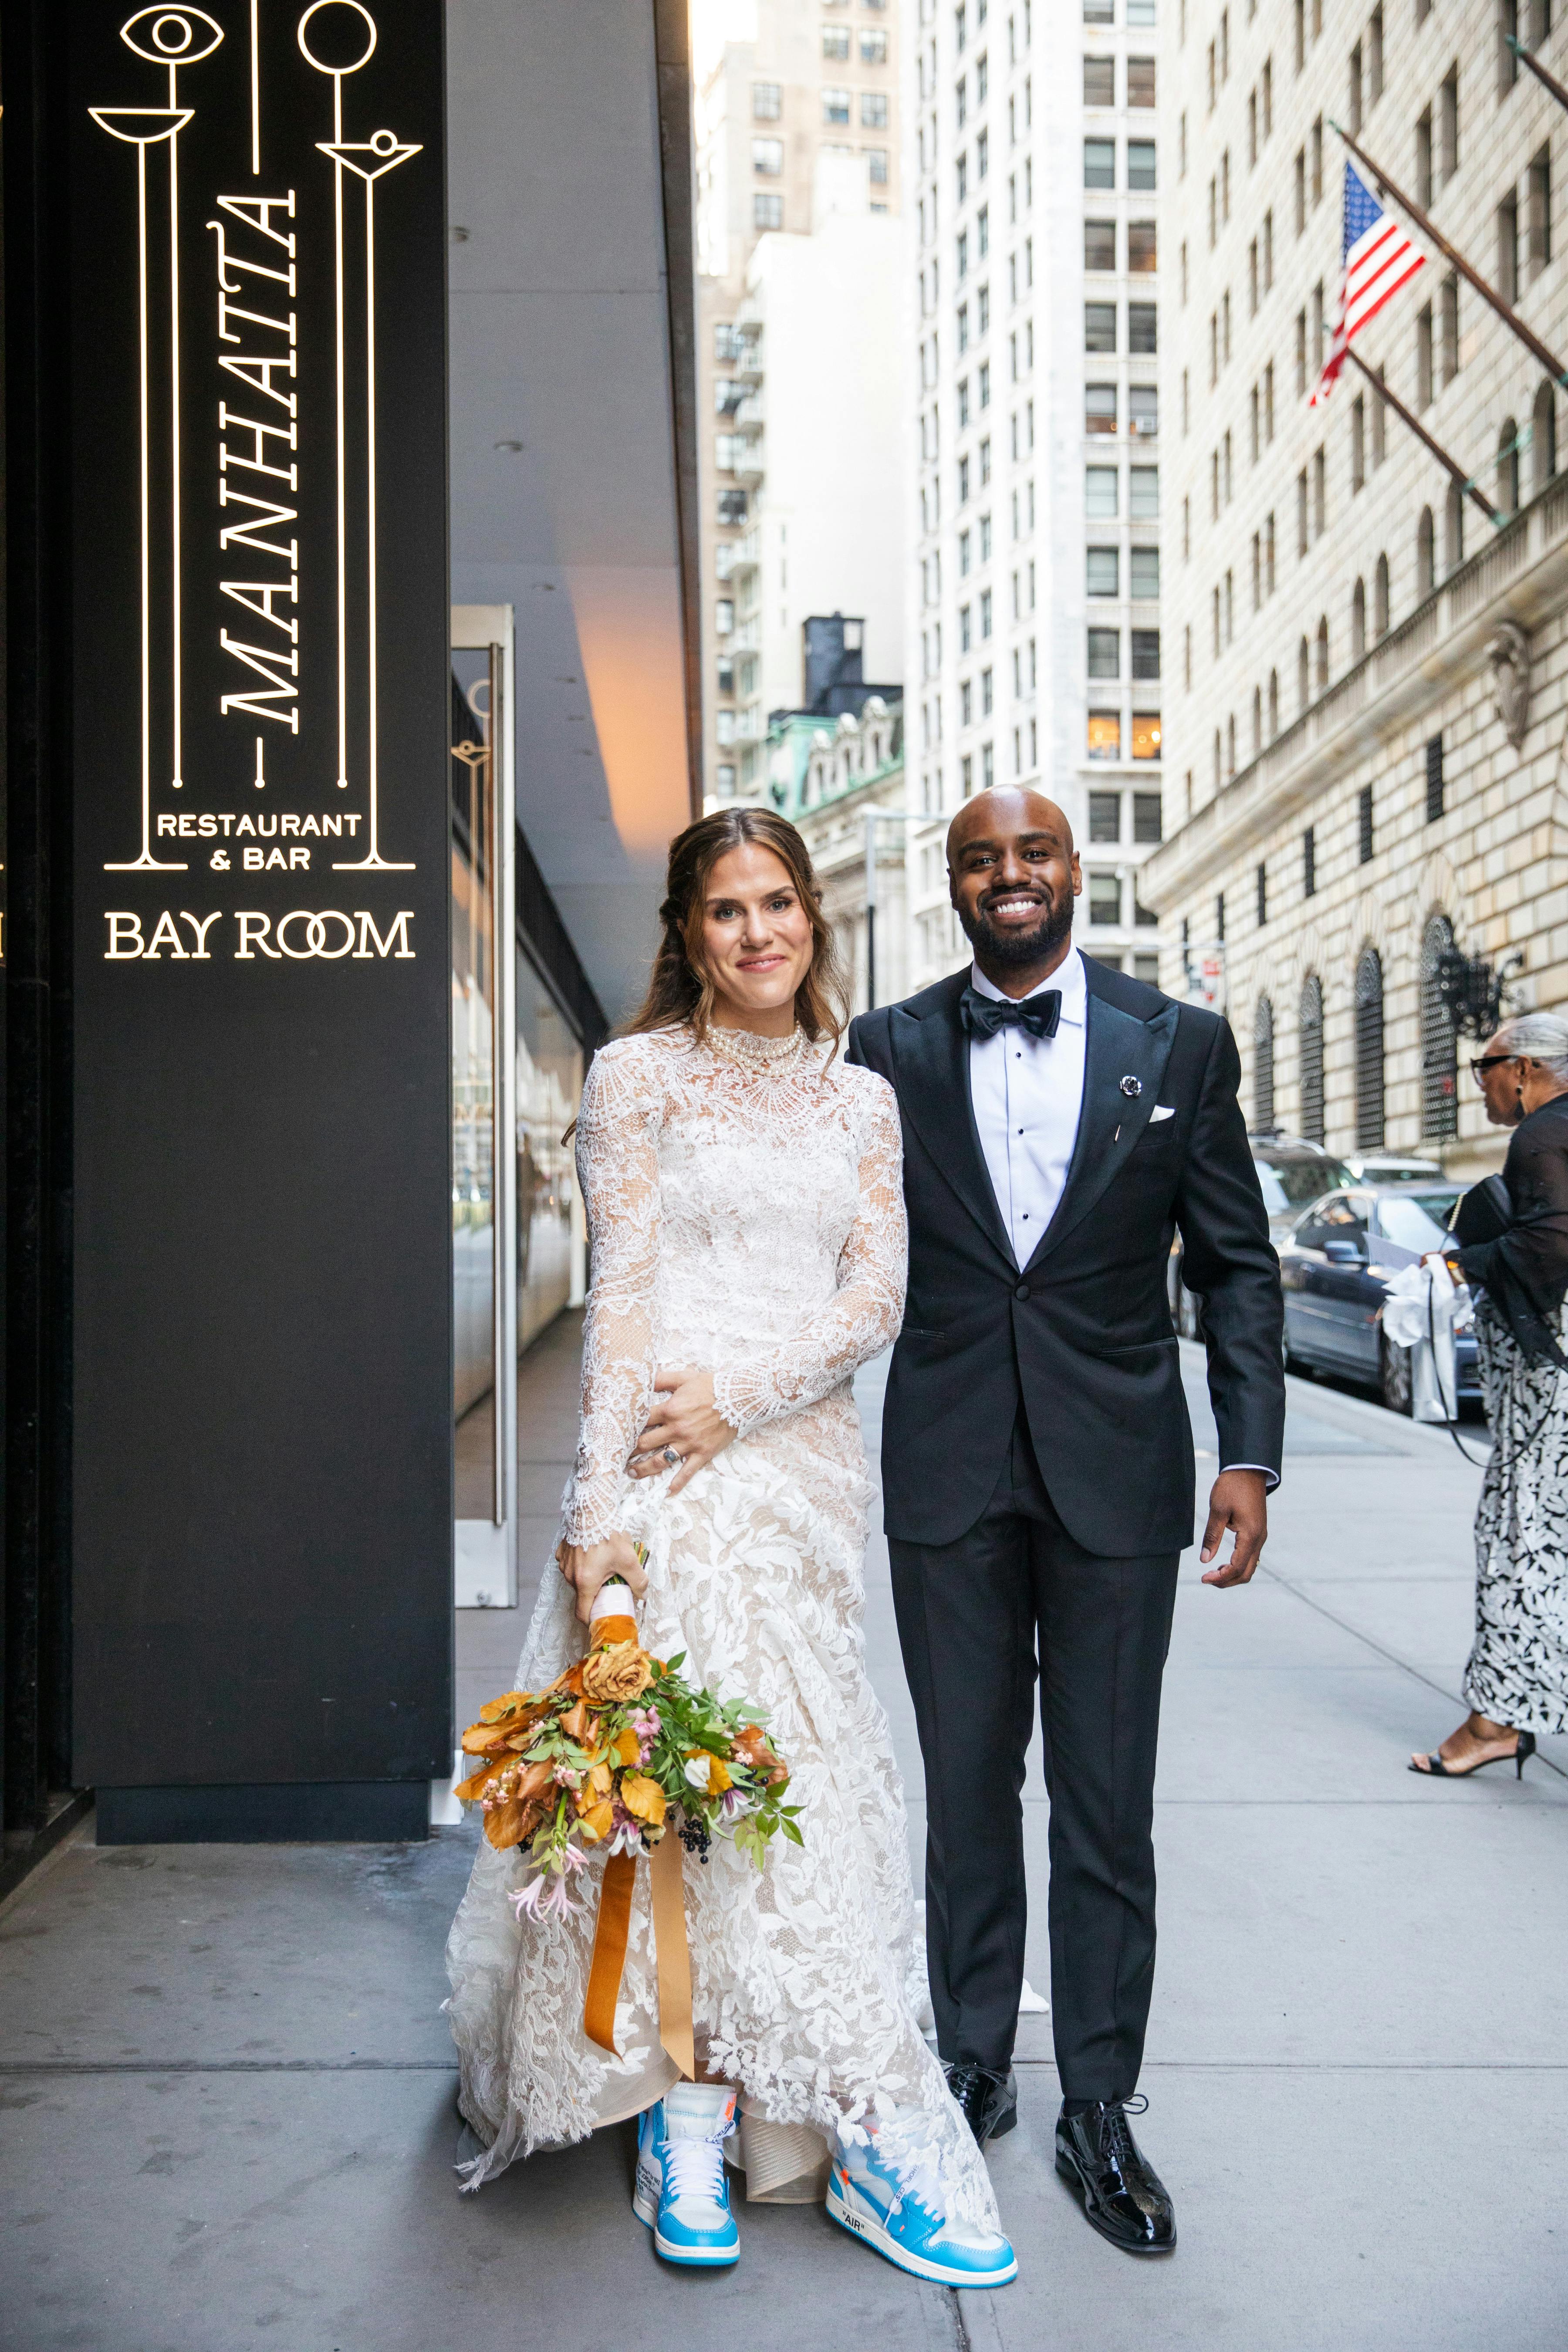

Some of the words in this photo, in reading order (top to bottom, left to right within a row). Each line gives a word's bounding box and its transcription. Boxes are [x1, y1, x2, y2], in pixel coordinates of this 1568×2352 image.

[205, 189, 299, 735] MANHATTA
[157, 814, 362, 837] RESTAURANT
[210, 849, 231, 871] &
[243, 847, 311, 870] BAR
[104, 910, 223, 959] BAY
[234, 910, 416, 959] ROOM
[842, 2210, 864, 2231] "AIR"
